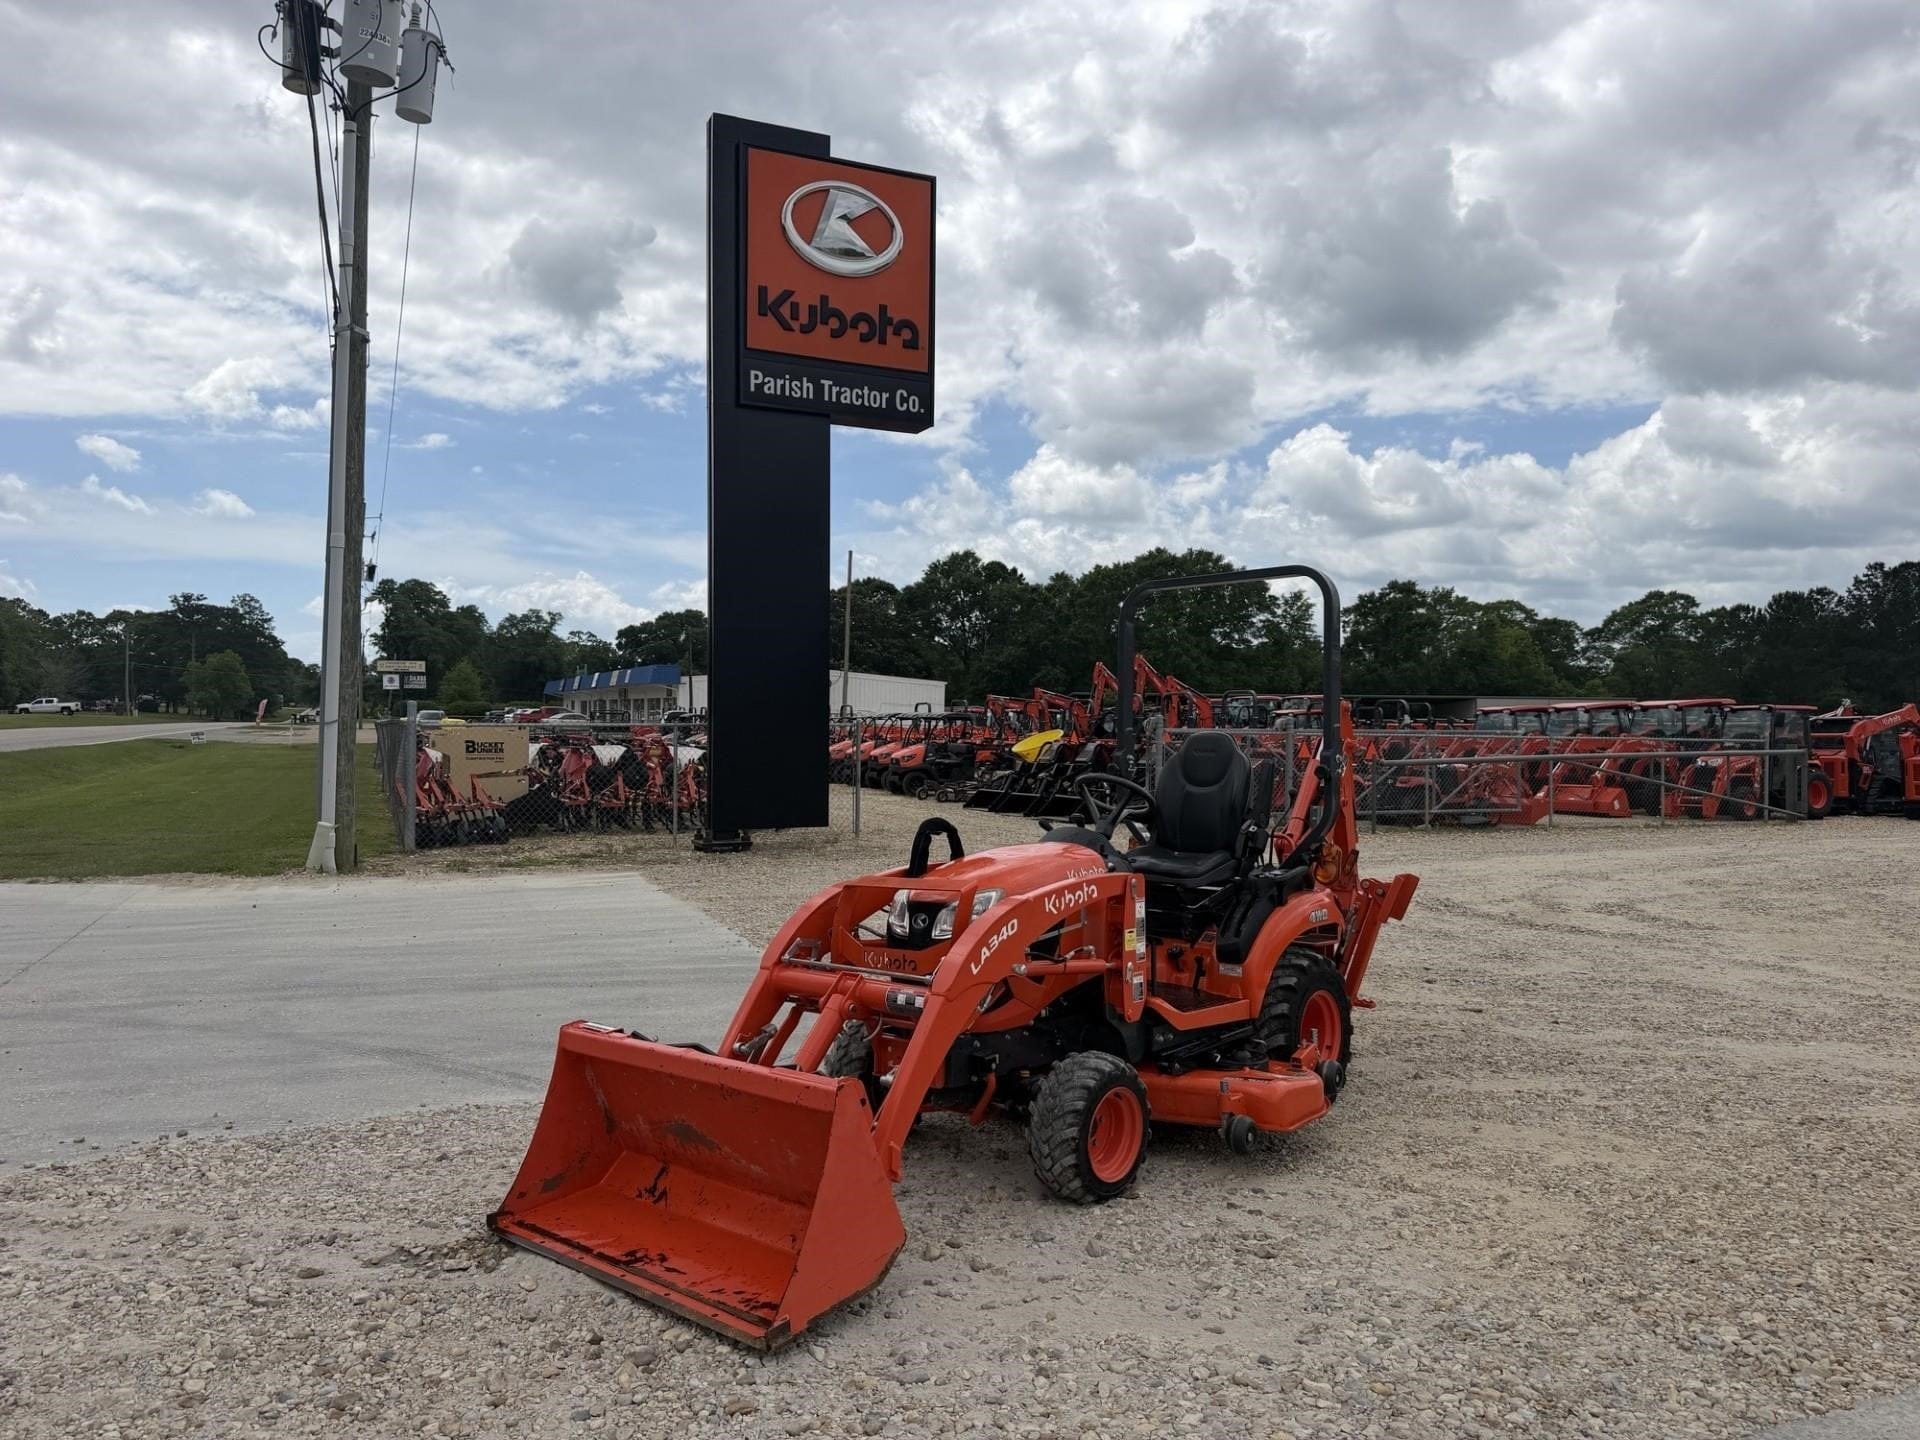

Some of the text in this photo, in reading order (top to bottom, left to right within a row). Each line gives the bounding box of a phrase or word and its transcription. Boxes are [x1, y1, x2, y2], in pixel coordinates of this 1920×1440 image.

[757, 285, 920, 351] Kubota
[750, 369, 925, 413] Parish Tractor Co.
[1044, 882, 1098, 915] Kubota
[1309, 909, 1328, 922] 4WD
[864, 951, 917, 972] Kubota
[970, 918, 1018, 976] LA340
